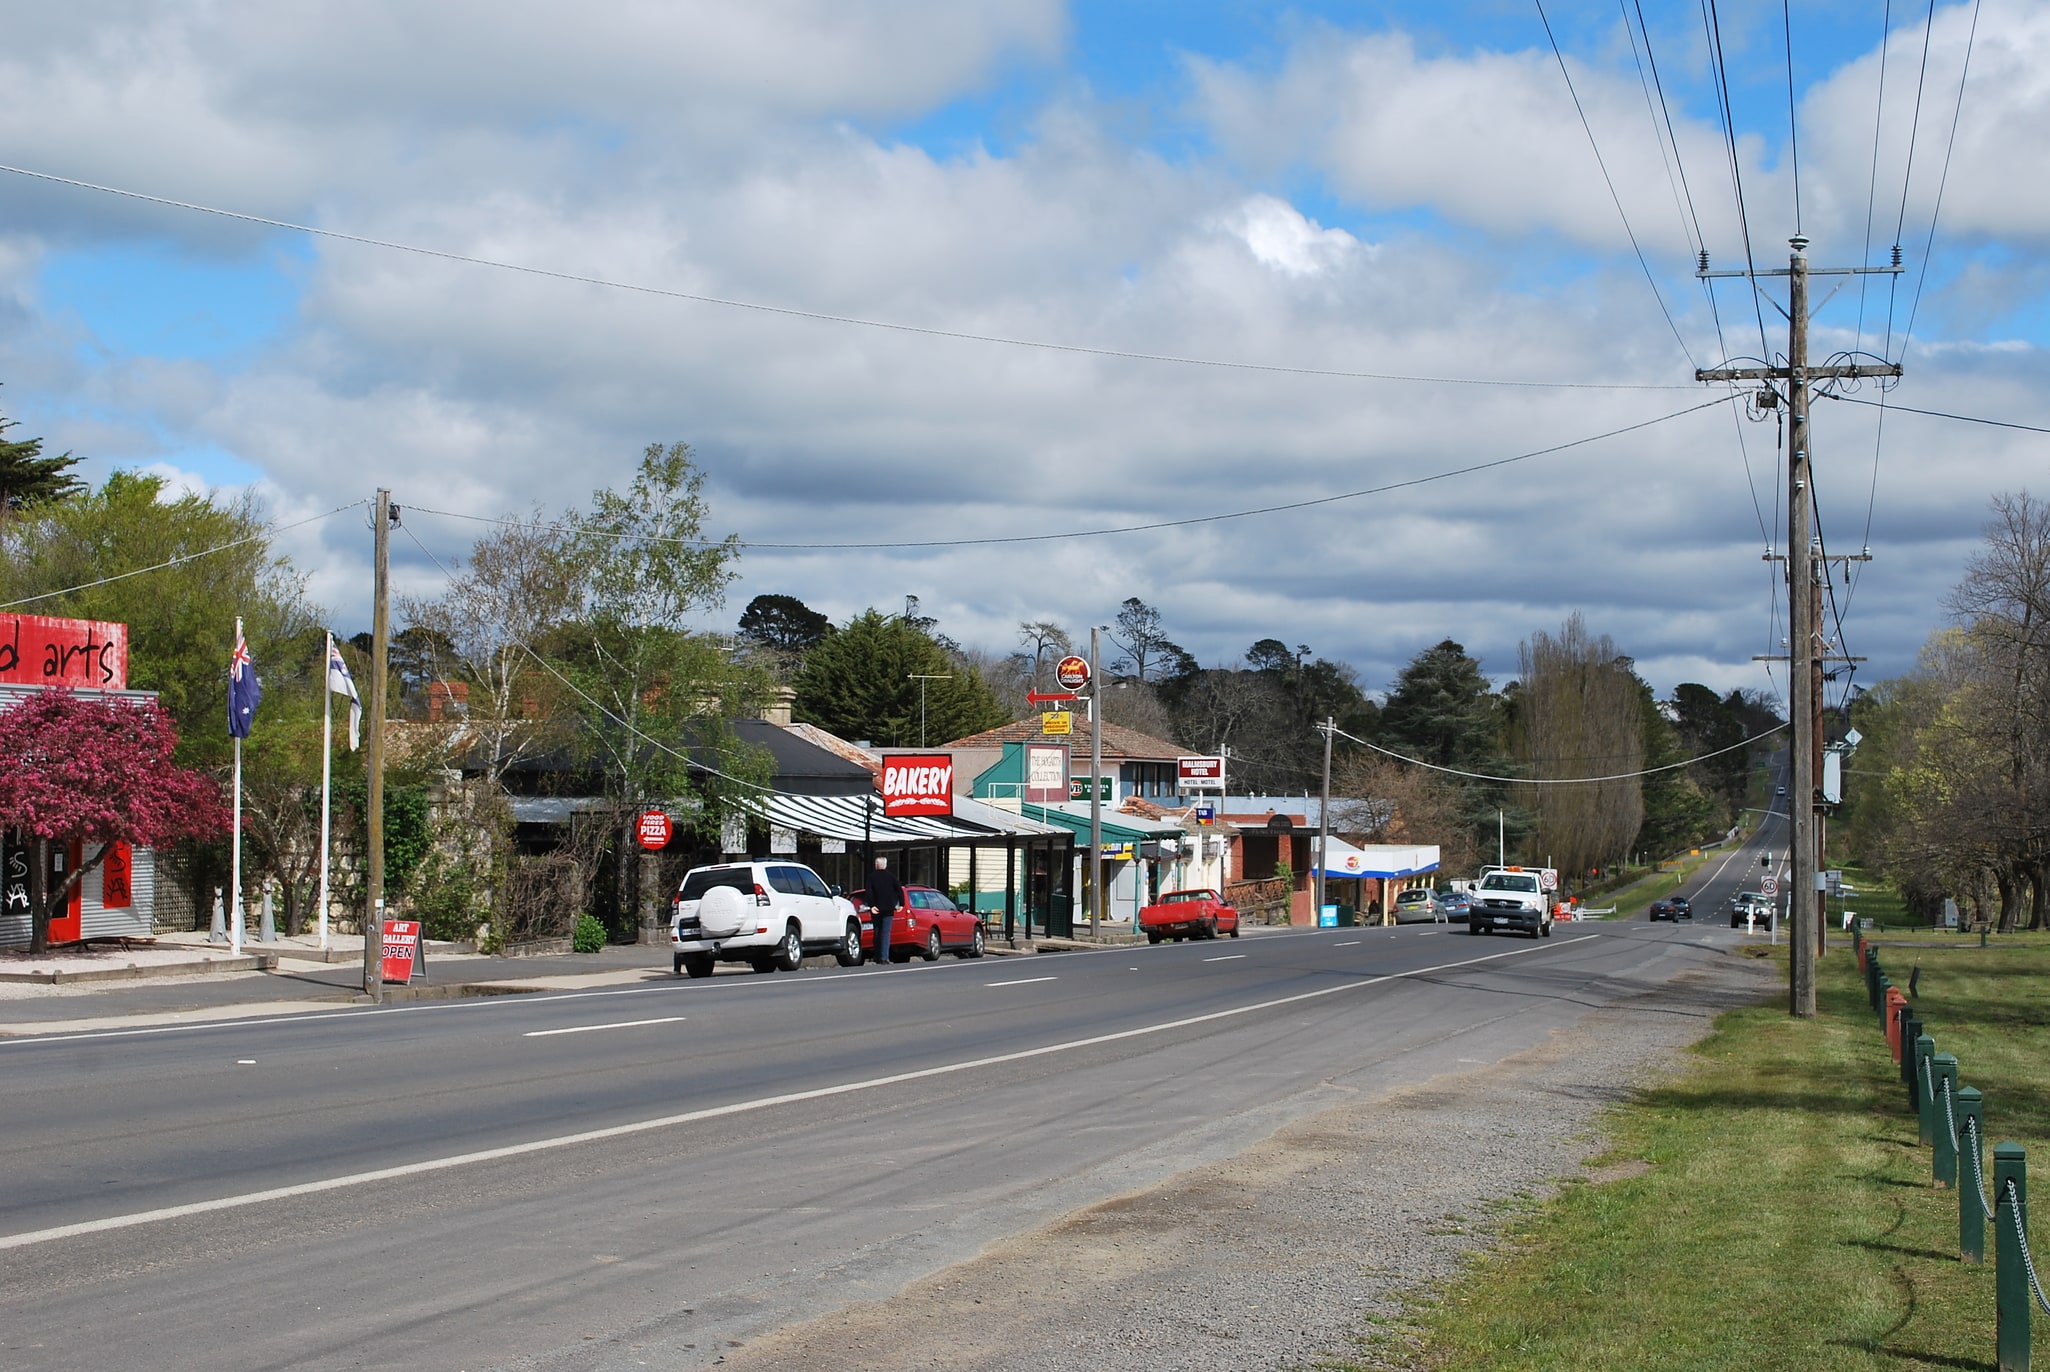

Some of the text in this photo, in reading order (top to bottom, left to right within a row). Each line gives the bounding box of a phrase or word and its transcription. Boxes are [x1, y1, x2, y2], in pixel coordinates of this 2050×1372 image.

[43, 627, 114, 684] arts
[883, 765, 952, 796] BAKERY
[640, 825, 667, 836] PIZZA
[1544, 875, 1554, 884] 60
[1761, 880, 1775, 890] 60
[392, 923, 410, 933] ART
[383, 934, 416, 945] GALLERY
[382, 945, 413, 959] OPEN
